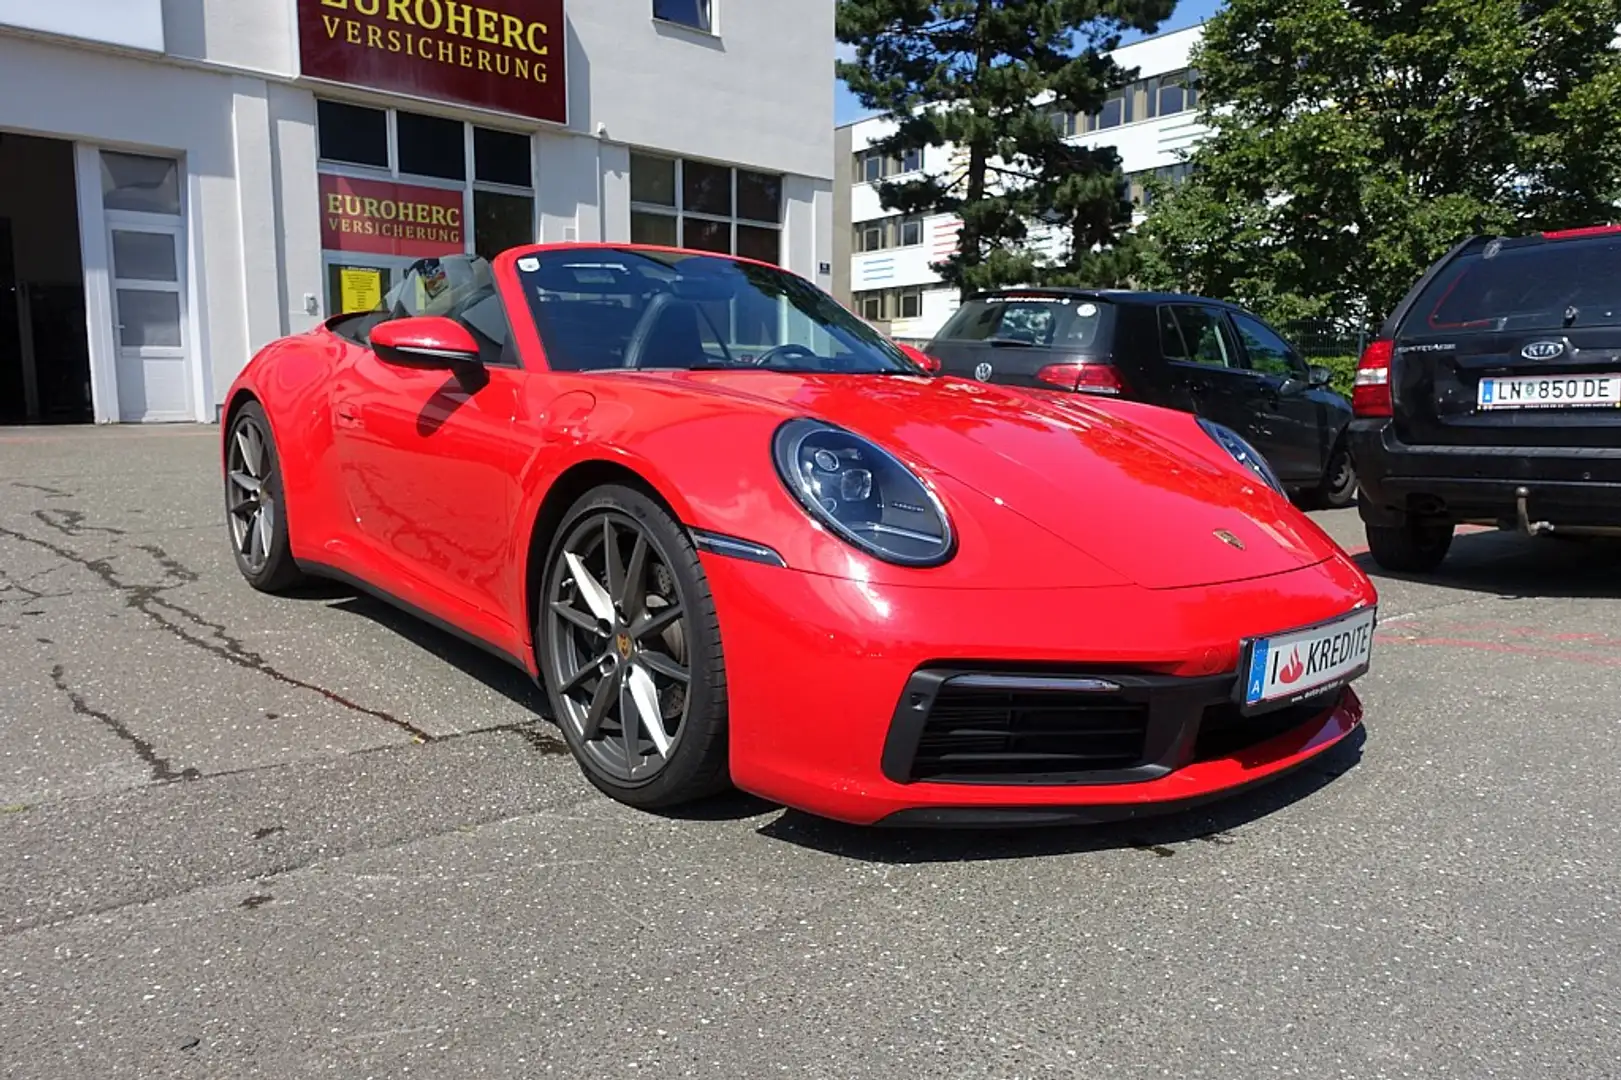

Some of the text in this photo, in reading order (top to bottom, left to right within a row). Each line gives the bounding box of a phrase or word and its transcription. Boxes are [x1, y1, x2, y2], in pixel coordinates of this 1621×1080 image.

[321, 0, 548, 55] ROHERC
[322, 15, 547, 83] VERSICHERUNG
[328, 193, 460, 227] EUROHERC
[329, 218, 459, 243] VERSICHERUNG
[1499, 381, 1522, 400] LN
[1538, 380, 1578, 399] 850
[1584, 378, 1611, 398] DE
[1251, 680, 1260, 695] A
[1306, 622, 1370, 676] KREDITE
